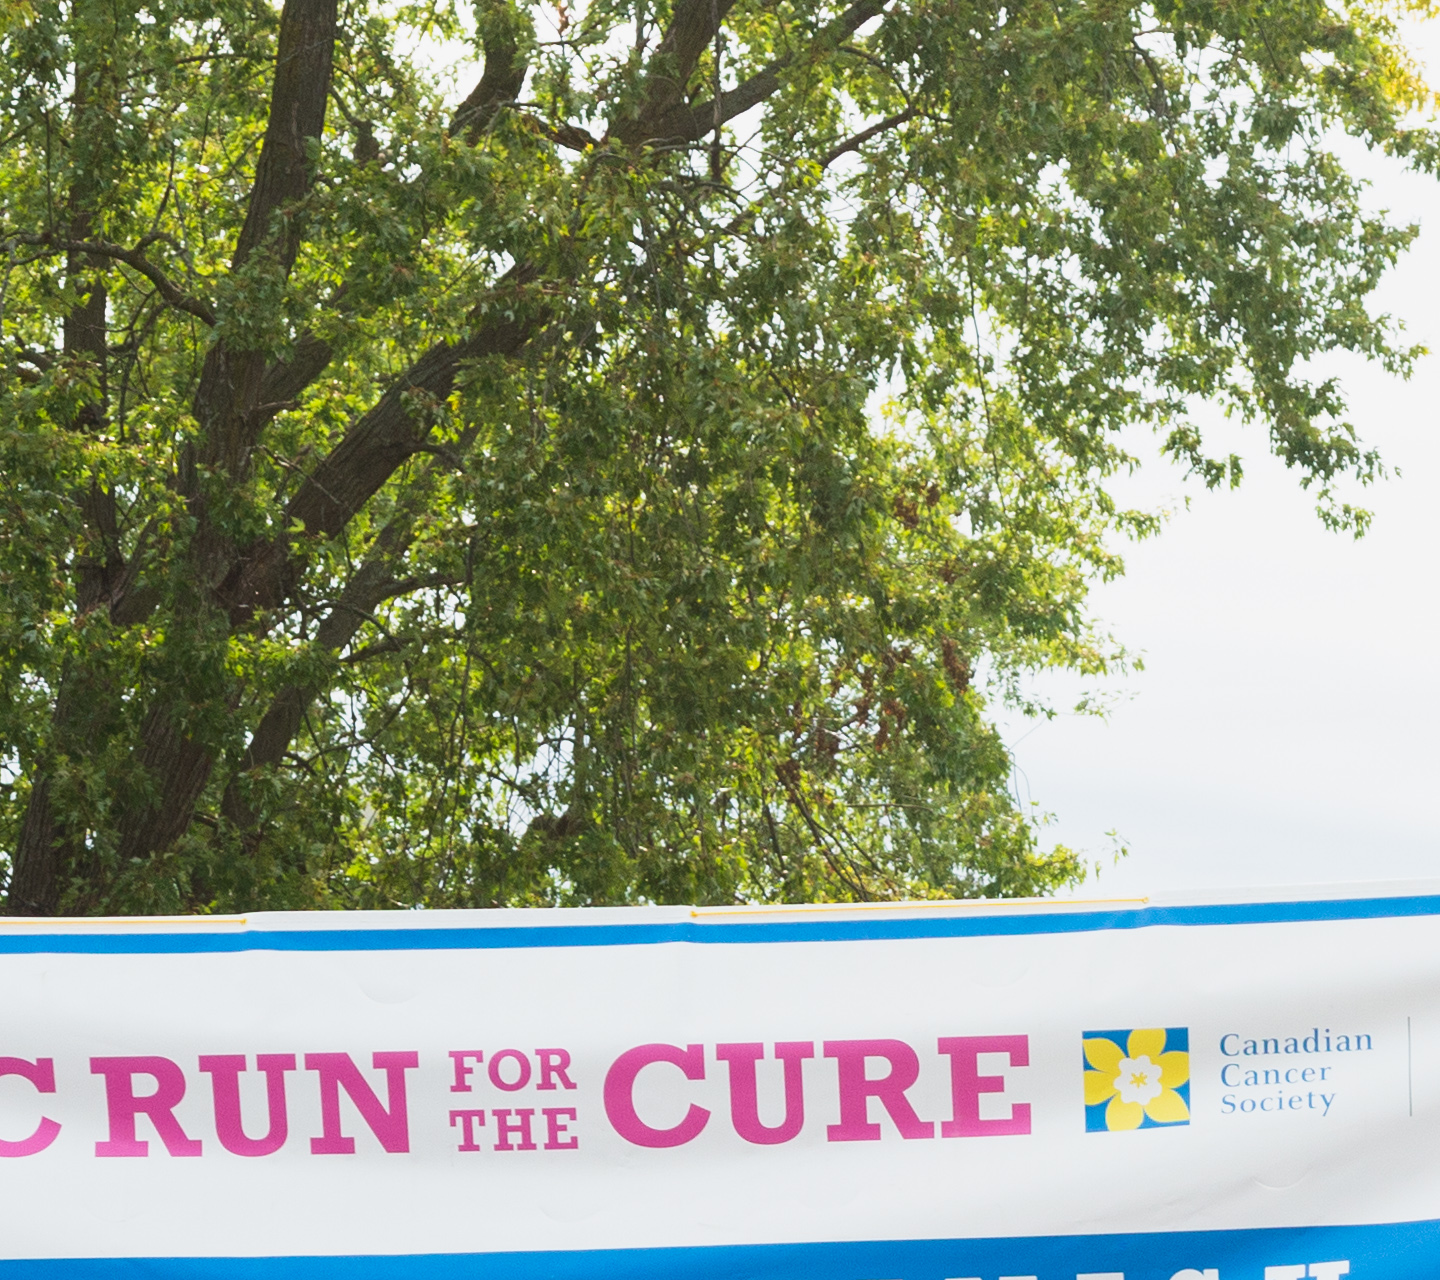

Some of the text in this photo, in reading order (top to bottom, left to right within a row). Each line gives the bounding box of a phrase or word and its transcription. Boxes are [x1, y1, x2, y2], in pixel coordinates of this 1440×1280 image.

[1219, 1027, 1373, 1057] Canadian
[448, 1048, 578, 1093] FOR
[602, 1034, 1032, 1149] CURE
[1221, 1062, 1332, 1087] Cancer
[89, 1051, 419, 1158] RUN
[1220, 1089, 1336, 1116] Society
[449, 1107, 579, 1152] THE
